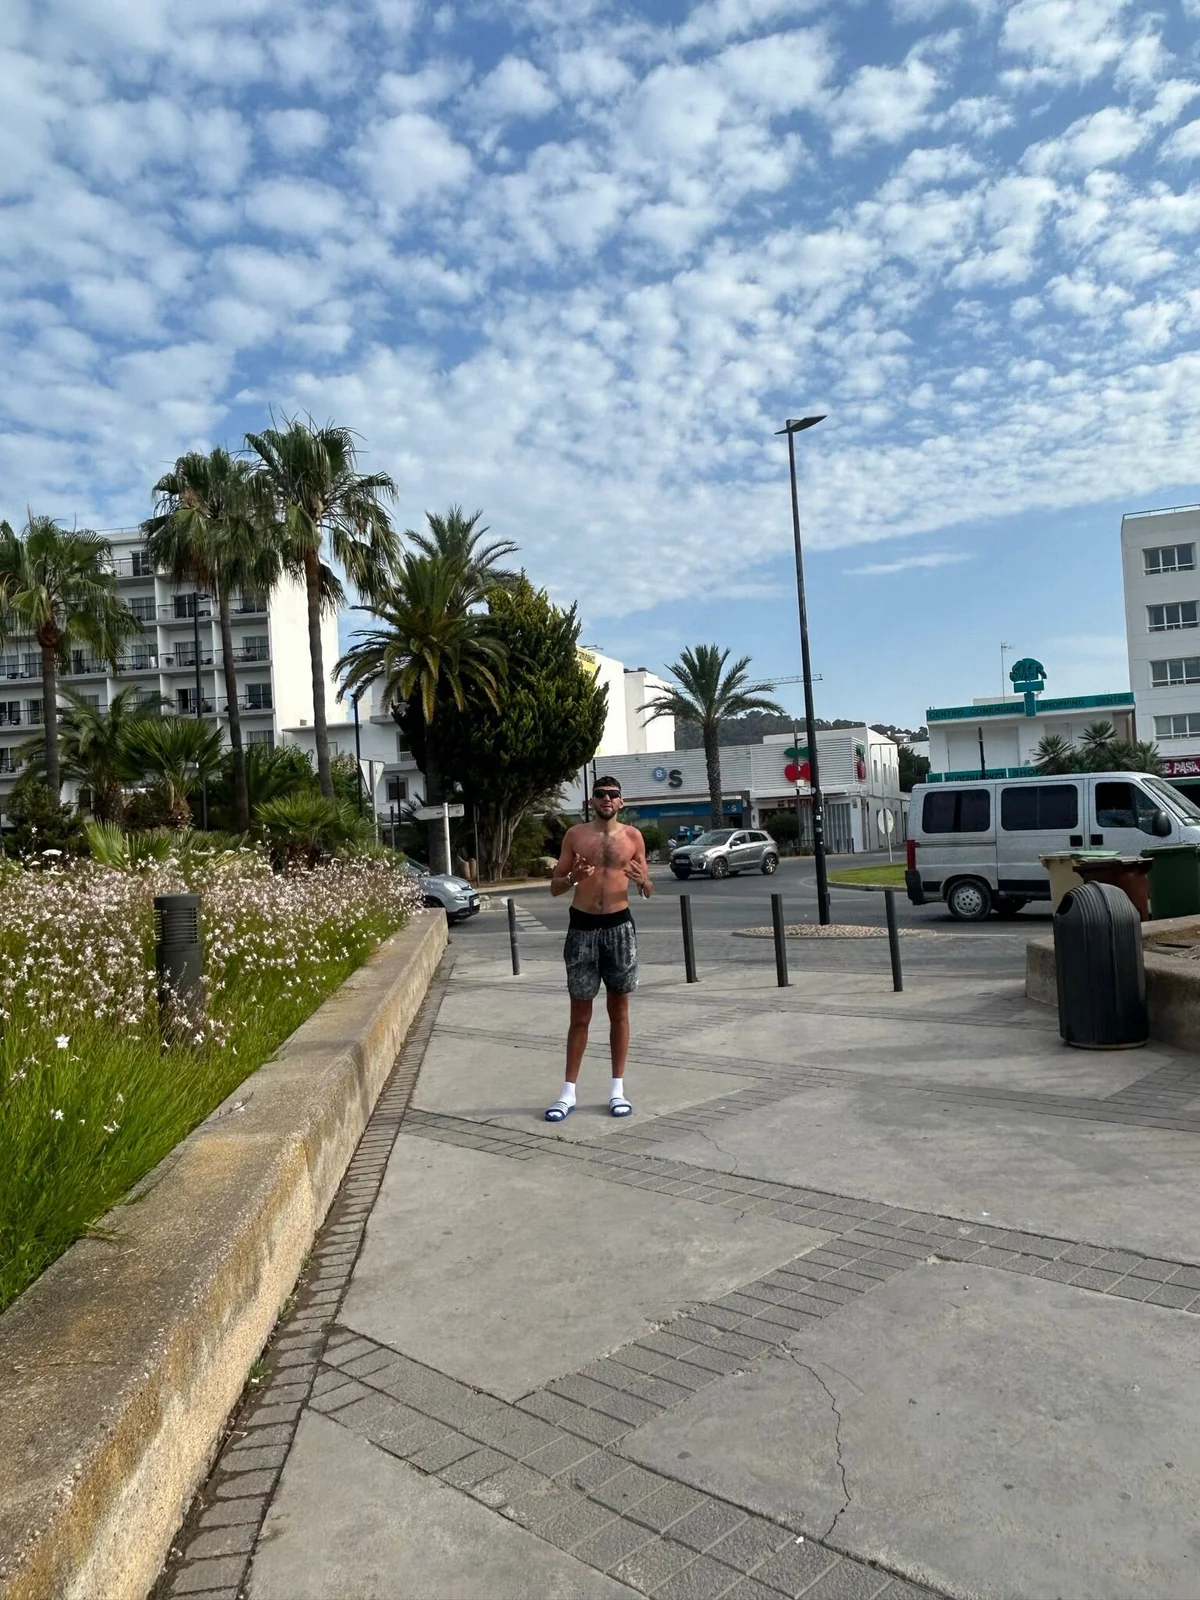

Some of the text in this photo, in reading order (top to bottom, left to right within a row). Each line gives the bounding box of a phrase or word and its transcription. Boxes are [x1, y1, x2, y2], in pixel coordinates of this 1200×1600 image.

[1040, 694, 1129, 709] SHOPPING CENTER
[929, 702, 1023, 719] CENTRO COMERCIAL
